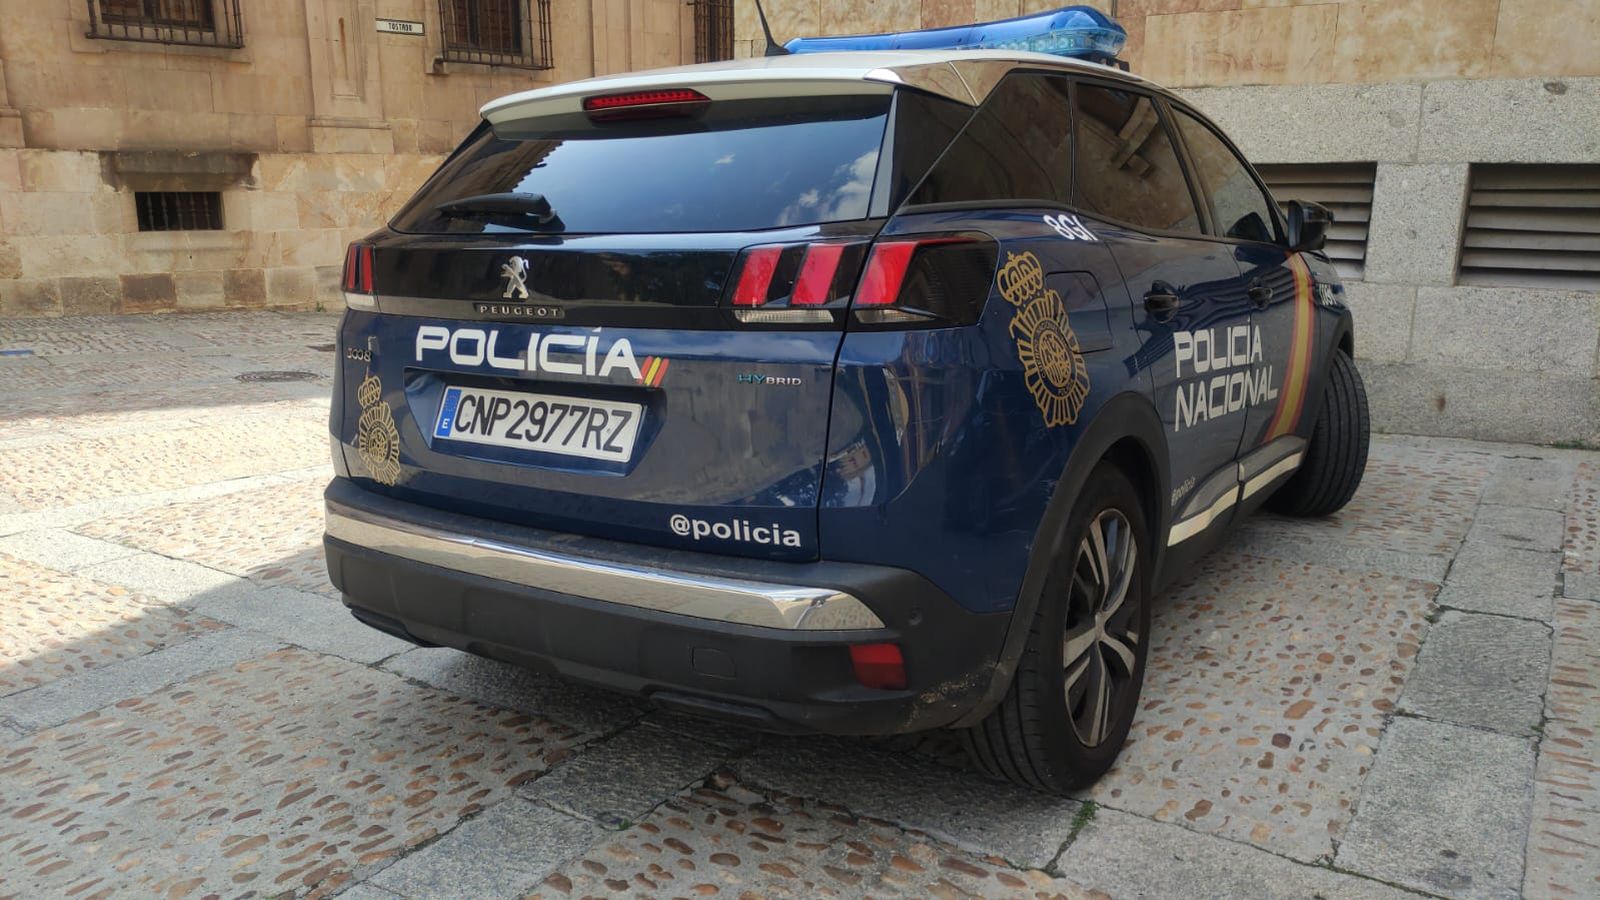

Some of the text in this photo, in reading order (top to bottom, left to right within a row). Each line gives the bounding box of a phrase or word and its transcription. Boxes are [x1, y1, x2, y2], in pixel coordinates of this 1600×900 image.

[480, 305, 558, 317] PEUGEOT
[415, 325, 643, 380] POLICÍA
[738, 374, 802, 386] HYBRID
[1174, 365, 1278, 432] NACIONAL
[454, 394, 633, 454] CNP2977RZ
[669, 513, 802, 548] @policia
